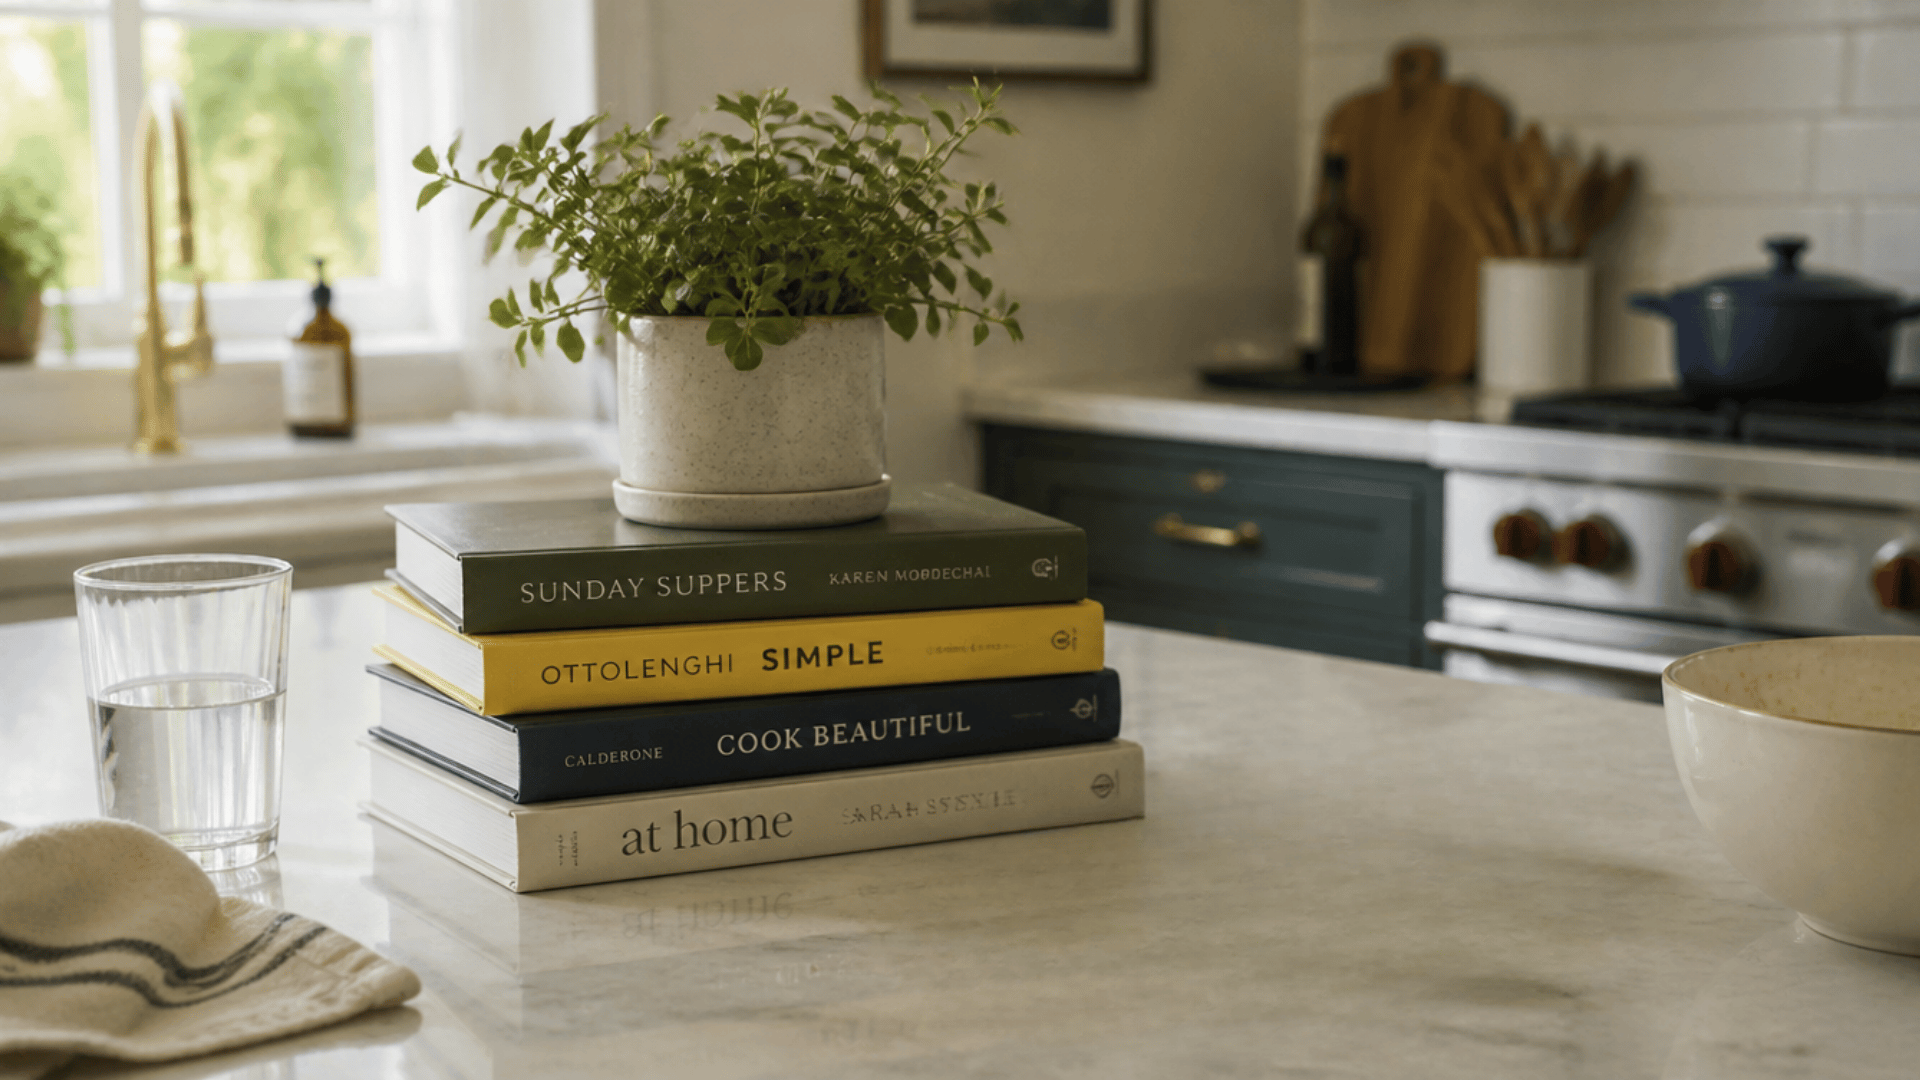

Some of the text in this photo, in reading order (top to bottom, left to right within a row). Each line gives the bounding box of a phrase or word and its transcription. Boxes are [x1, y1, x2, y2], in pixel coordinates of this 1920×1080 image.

[520, 577, 644, 604] SUNDAY
[656, 570, 787, 597] SUPPERS
[829, 570, 888, 585] KAREN
[540, 640, 884, 685] OTTOLENGHI SIMPLE
[564, 711, 971, 768] CALDERONE COOK BEAUTIFUL
[622, 822, 662, 857] at
[673, 808, 794, 850] home
